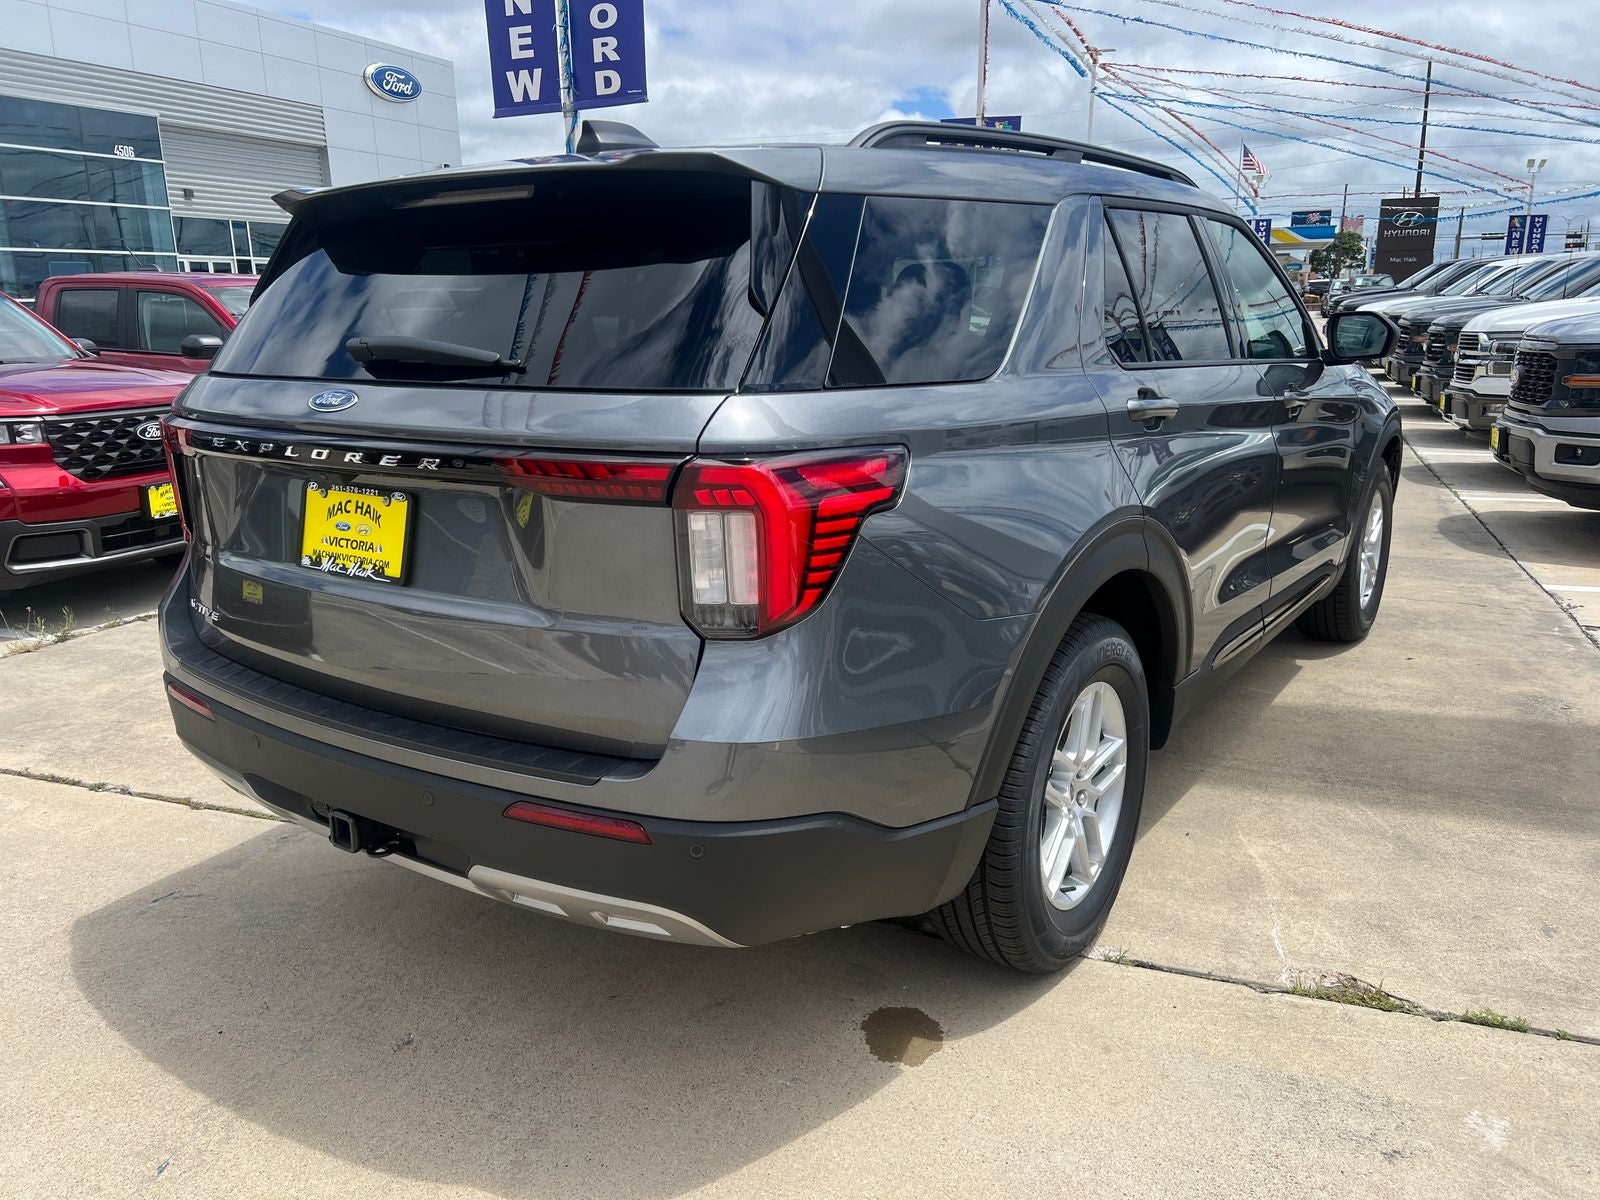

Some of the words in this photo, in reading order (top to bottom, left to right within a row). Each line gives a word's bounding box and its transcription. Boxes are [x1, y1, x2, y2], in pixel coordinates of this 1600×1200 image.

[589, 3, 621, 96] ORD
[383, 71, 413, 95] Ford
[114, 145, 134, 158] 4506
[1384, 229, 1430, 238] HYUNDAI
[1509, 232, 1520, 255] NEW
[145, 425, 162, 438] For
[212, 436, 440, 471] EXPLORER
[327, 500, 352, 521] MAC
[354, 500, 382, 529] HAIK
[328, 536, 375, 553] VICTORIA
[319, 556, 347, 573] Mac
[346, 561, 384, 580] Haik
